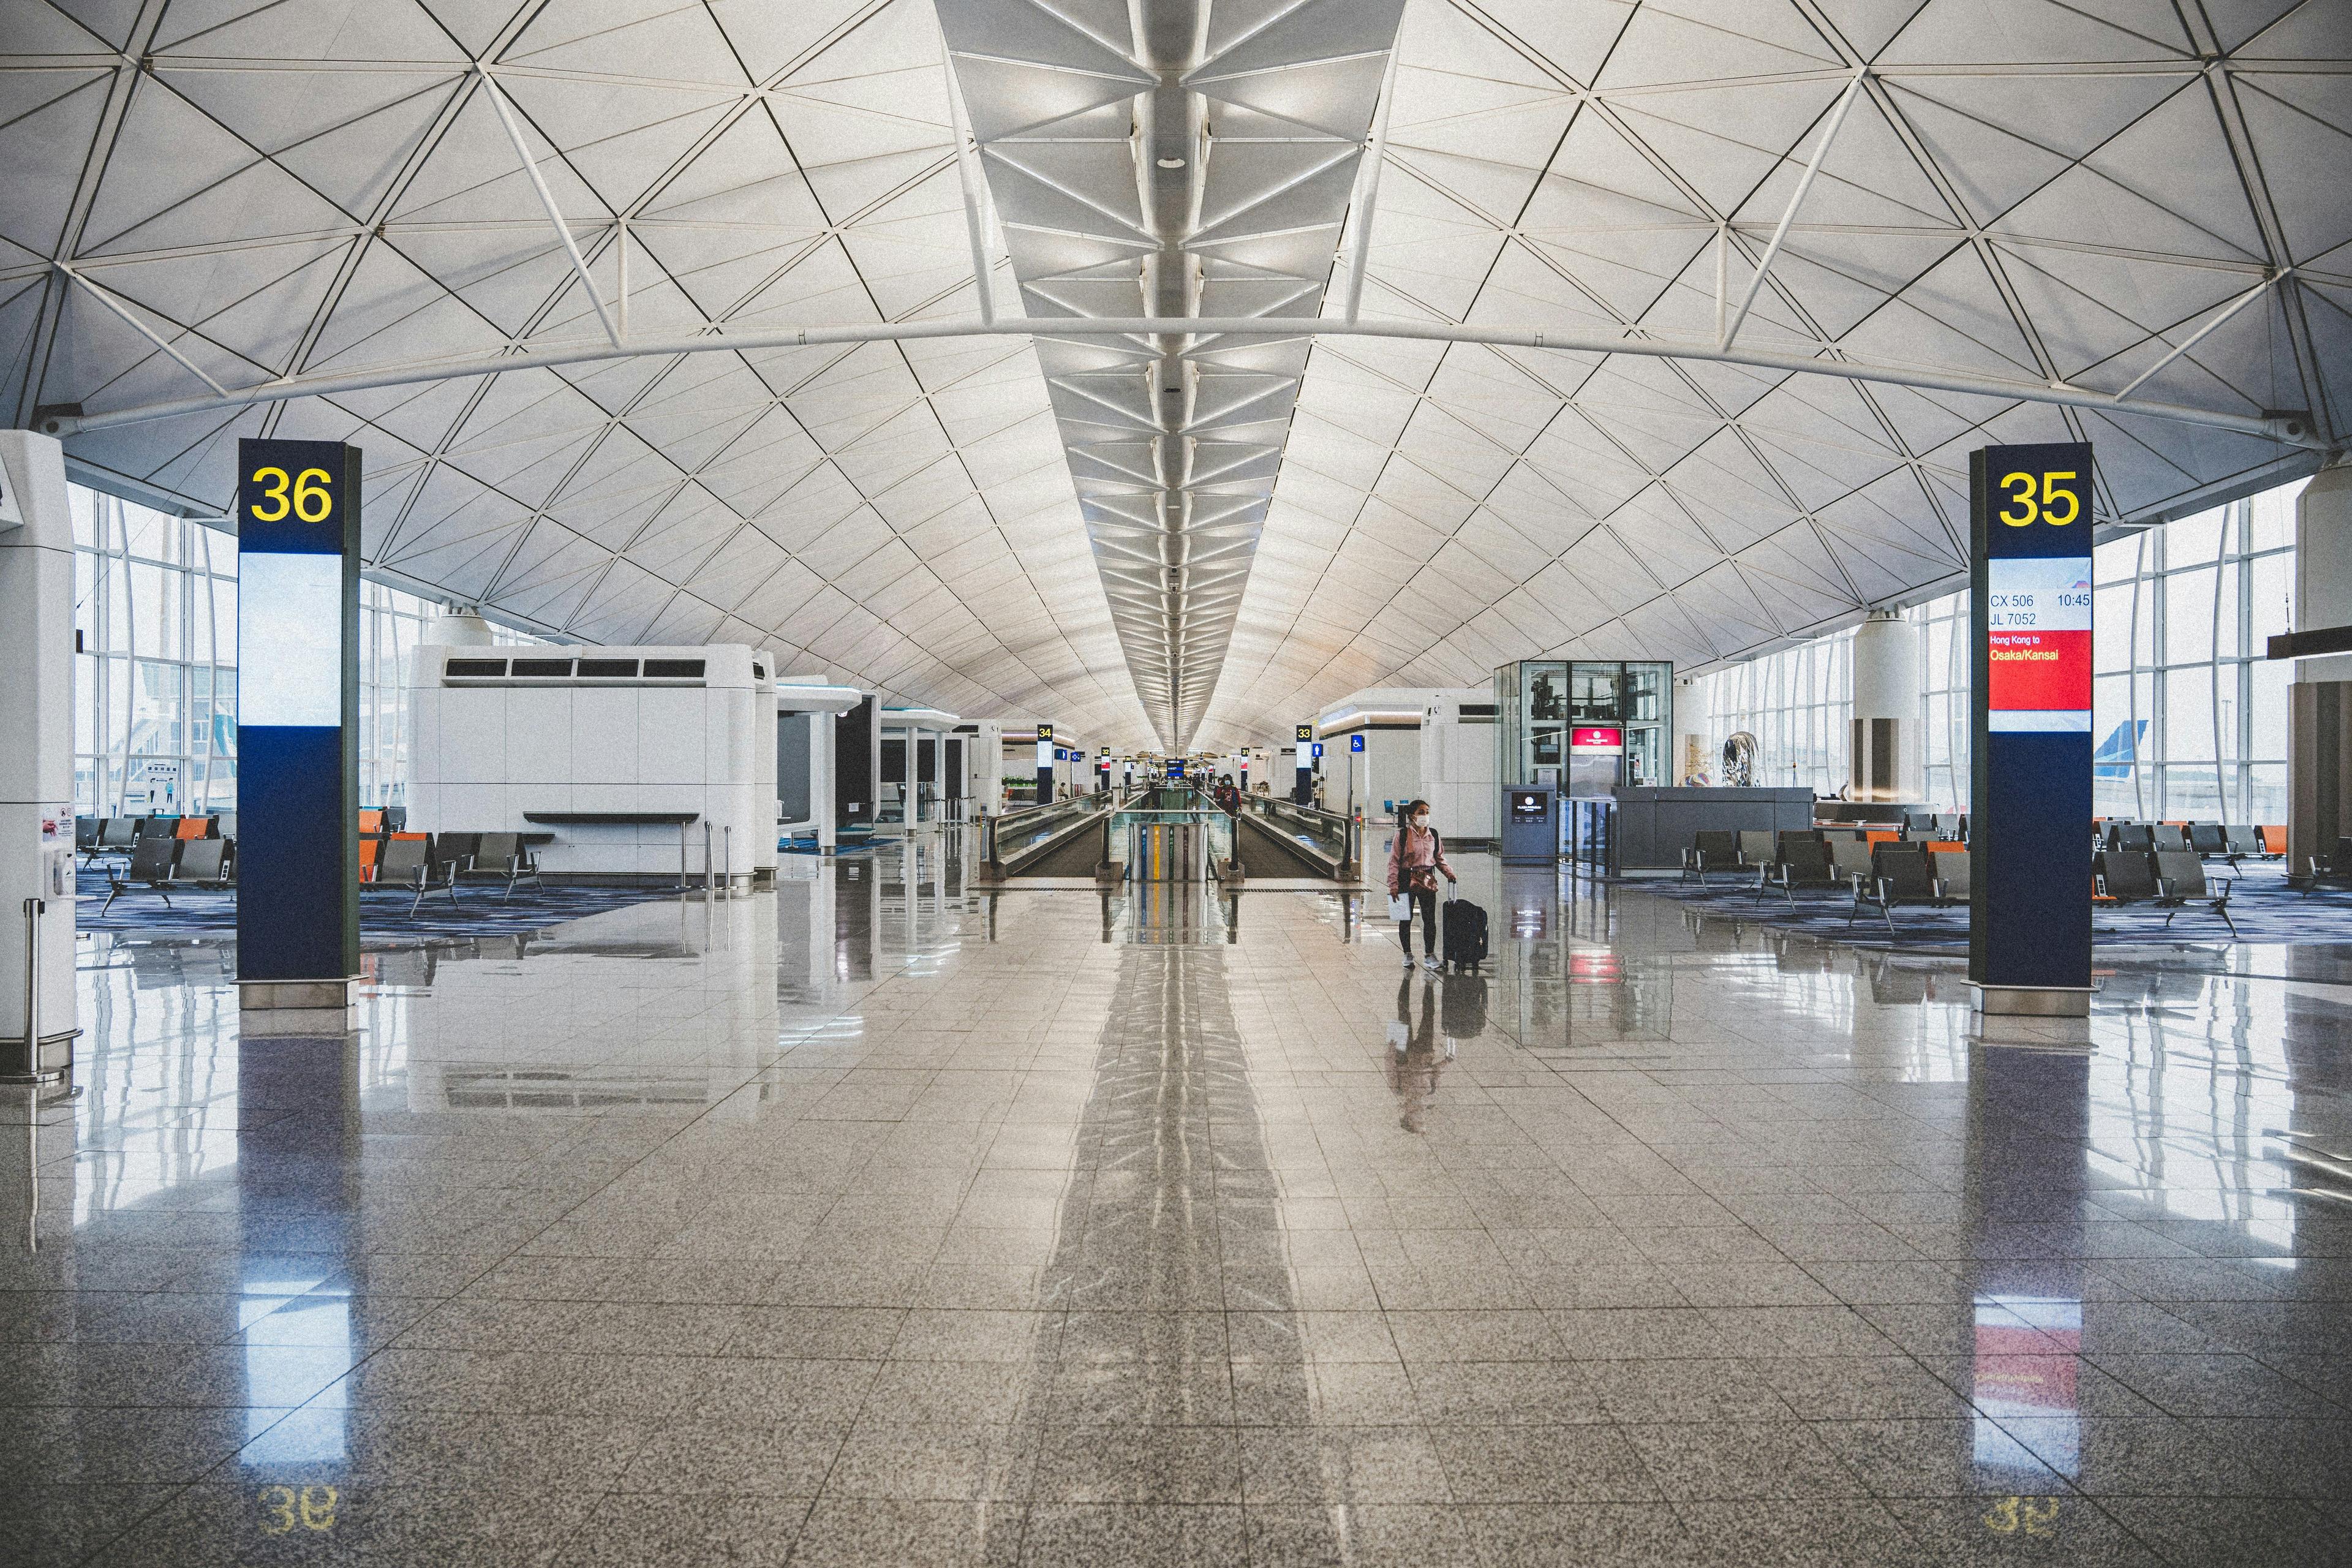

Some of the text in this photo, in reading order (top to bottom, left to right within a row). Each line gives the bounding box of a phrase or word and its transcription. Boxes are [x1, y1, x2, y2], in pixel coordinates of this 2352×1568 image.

[251, 467, 332, 522] 36
[1999, 471, 2079, 527] 35
[1991, 595, 2034, 606] CX 506
[2058, 594, 2090, 606] 10:45
[1991, 613, 2036, 625] JL 7052
[1990, 636, 2010, 646] Hong
[2011, 635, 2030, 646] Kong
[1990, 649, 2059, 660] Osaka/Kansai
[1039, 728, 1051, 737] 34
[1298, 729, 1310, 737] 33
